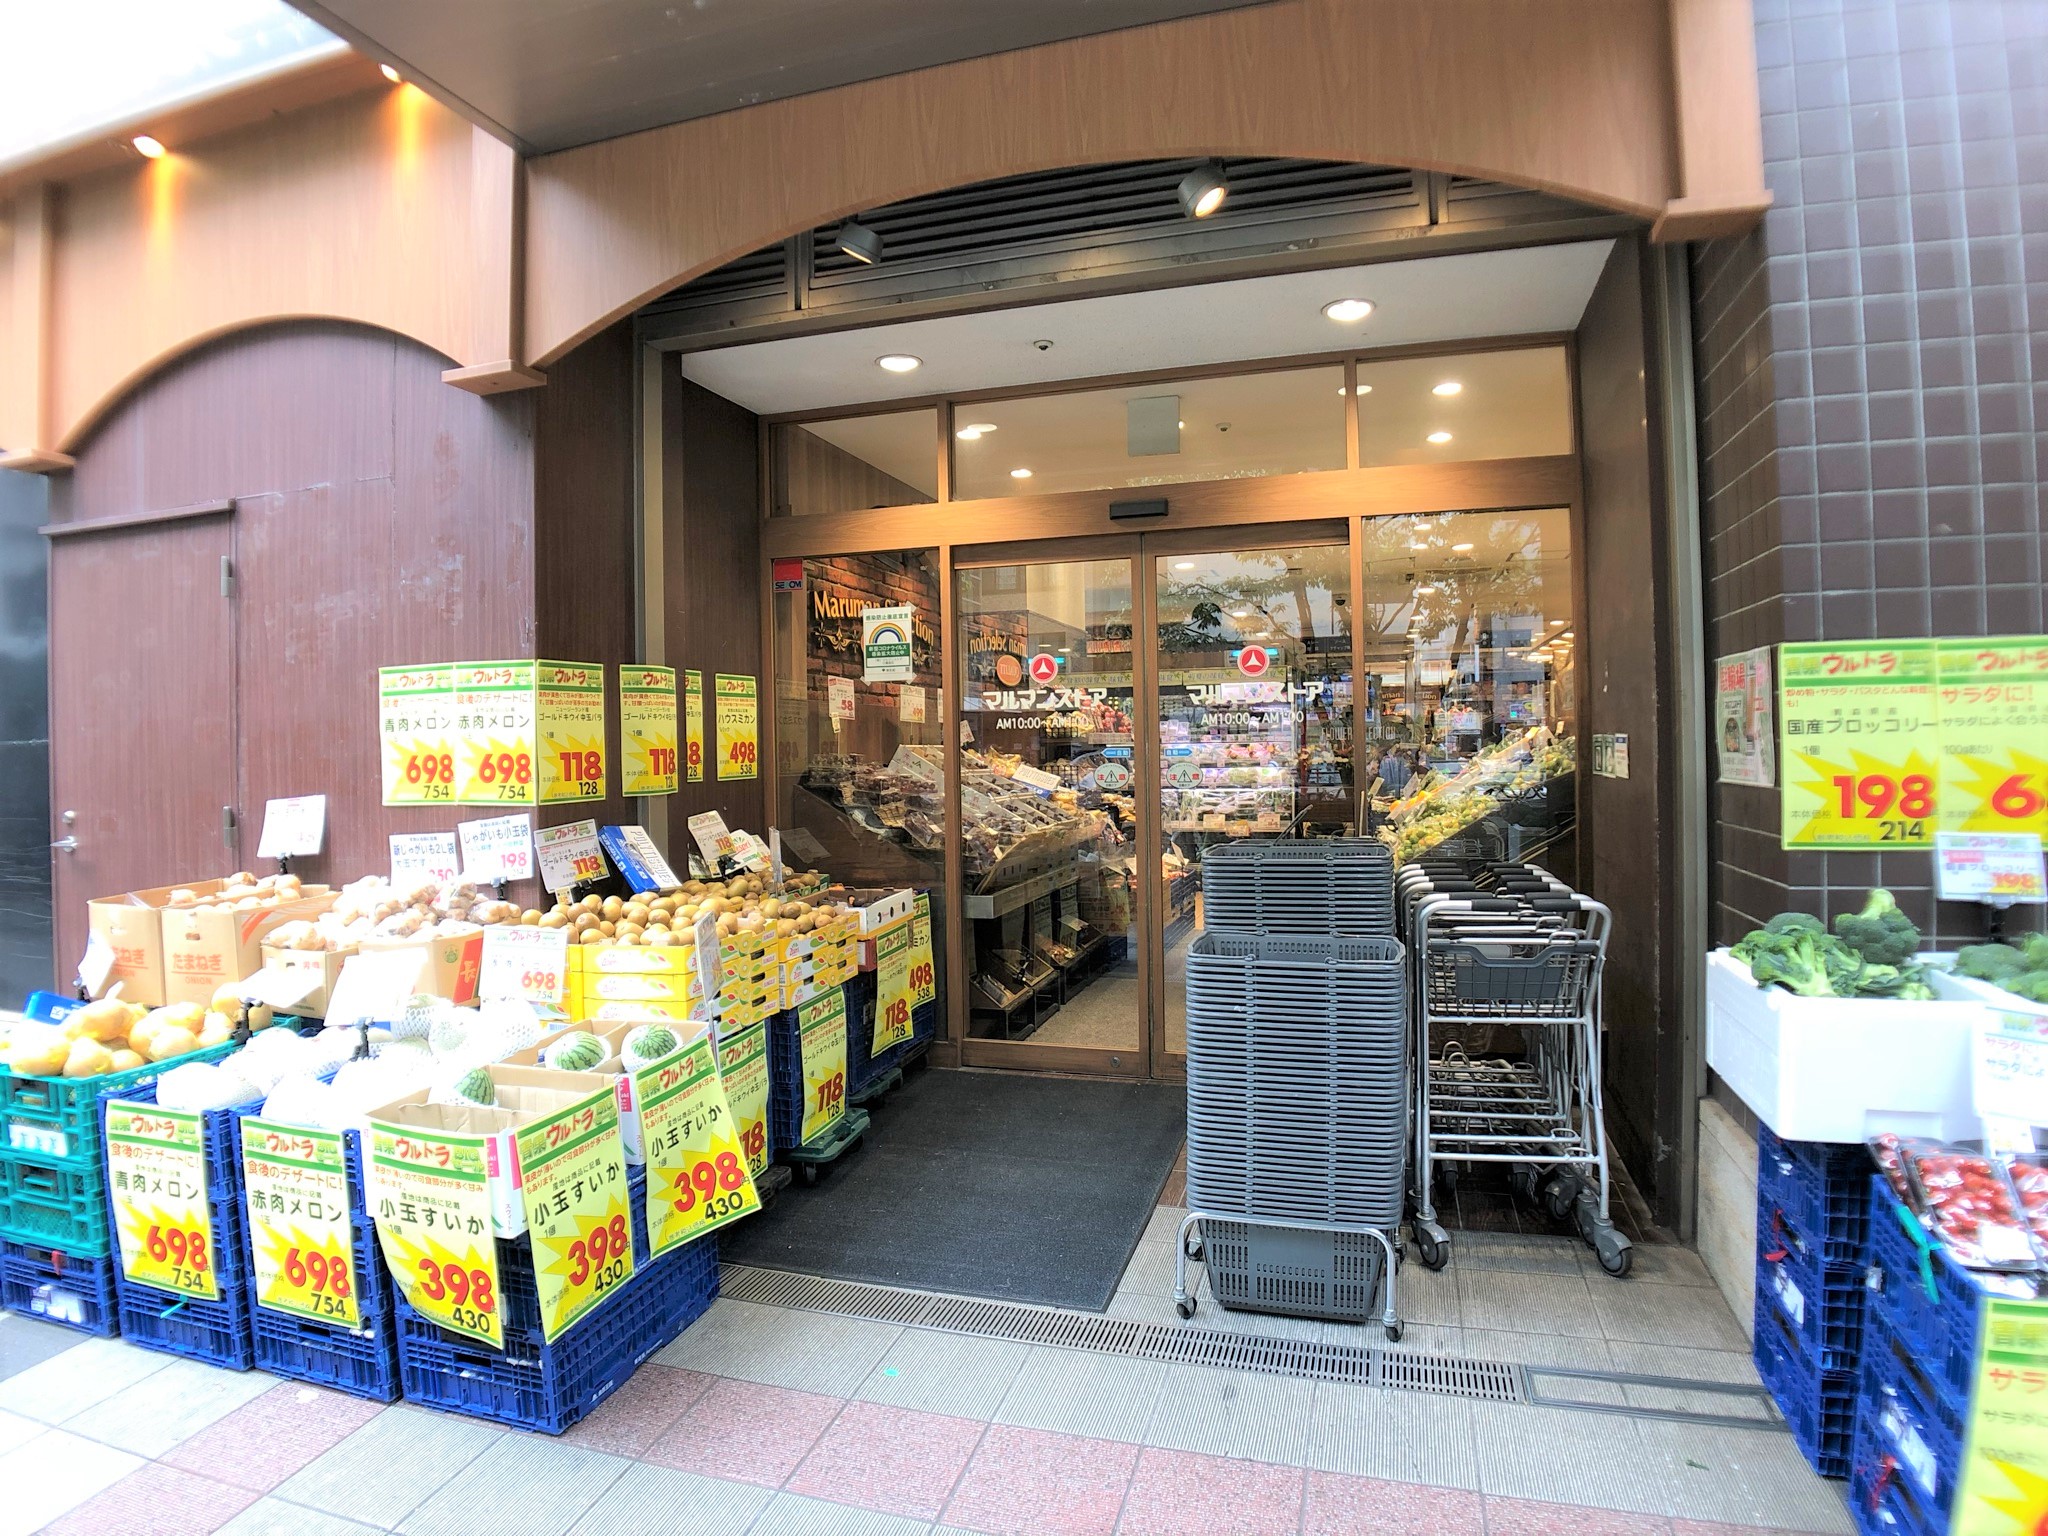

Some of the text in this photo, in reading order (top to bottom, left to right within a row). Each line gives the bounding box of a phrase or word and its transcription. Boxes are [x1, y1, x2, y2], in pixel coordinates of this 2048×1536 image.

[775, 580, 802, 589] SEOM
[1822, 653, 1898, 675] ウルトラ
[400, 673, 434, 688] ウルトラ
[474, 669, 513, 684] ウルトラ
[555, 668, 586, 685] ウルトラ
[643, 672, 667, 686] ウルトラ
[726, 680, 745, 692] ウルトラ
[982, 688, 1107, 710] マルマンストア
[1186, 682, 1324, 705] マルマンストア
[1942, 684, 2034, 704] サラダに!
[841, 700, 853, 711] 58
[385, 717, 450, 732] 青肉メロン
[458, 715, 530, 729] 赤肉メロン
[718, 713, 755, 724] ハウスミカン
[1788, 717, 1938, 735] 国産ブロッコリー
[1322, 726, 1352, 740] FLOWER
[730, 741, 756, 764] 498
[1802, 745, 1820, 756] 1個
[406, 754, 454, 784] 698
[479, 753, 532, 784] 698
[560, 751, 602, 781] 118
[649, 748, 675, 776] 118
[740, 764, 753, 775] 538
[424, 785, 450, 799] 754
[498, 785, 526, 799] 754
[579, 781, 598, 795] 128
[1791, 774, 1938, 819] 本体価格 198
[1992, 773, 2048, 819] 6
[463, 824, 529, 844] じゃがいも小玉袋
[554, 826, 577, 840] ウルトラ
[1879, 820, 1927, 841] 214
[716, 836, 731, 850] 118
[501, 852, 527, 868] 198
[573, 855, 601, 874] 118
[1992, 872, 2037, 889] 198
[510, 930, 540, 942] ウルトラ
[884, 931, 900, 950] ウルトラ
[172, 953, 223, 971] たまねぎ
[460, 960, 476, 983] 長
[185, 976, 212, 985] ONION
[522, 971, 556, 990] 698
[909, 962, 933, 991] 498
[917, 988, 931, 1000] 538
[810, 998, 832, 1021] ウルトラ
[885, 998, 909, 1032] 118
[892, 1024, 906, 1040] 128
[726, 1038, 752, 1065] ウルトラ
[659, 1056, 694, 1089] ウルトラ
[817, 1071, 843, 1113] 118
[827, 1100, 840, 1120] 128
[131, 1114, 176, 1139] ウルトラ
[645, 1114, 671, 1130] もあります。
[652, 1104, 722, 1158] 小玉すいか
[519, 1135, 547, 1161] 青果
[546, 1107, 593, 1147] ウルトラ
[740, 1120, 765, 1161] 18
[111, 1143, 200, 1169] 食後のデザートに!
[266, 1133, 314, 1159] ウルトラ
[395, 1138, 450, 1166] ウルトラ
[524, 1129, 616, 1183] 果皮が薄いので可食部分が多く甘み
[658, 1156, 667, 1168] 1個
[747, 1154, 761, 1172] 28
[115, 1170, 199, 1200] 青肉メロン
[247, 1160, 343, 1191] 食後のデザートに!
[552, 1157, 601, 1191] 産地は商品に記載
[526, 1176, 557, 1195] もあります。
[534, 1162, 620, 1226] 小玉すいか
[651, 1211, 675, 1229] 本体価格
[674, 1151, 744, 1213] 398
[252, 1190, 342, 1222] 赤肉メロン
[401, 1193, 460, 1210] 産地は商品に記載
[706, 1191, 743, 1220] 430
[380, 1198, 485, 1235] 小玉すいか
[389, 1224, 402, 1235] 1個
[544, 1224, 556, 1239] 1個
[146, 1225, 209, 1272] 698
[568, 1214, 628, 1286] 398
[172, 1267, 204, 1292] 754
[284, 1248, 350, 1298] 698
[594, 1259, 623, 1293] 430
[419, 1258, 495, 1314] 398
[310, 1293, 346, 1318] 754
[453, 1308, 490, 1333] 430
